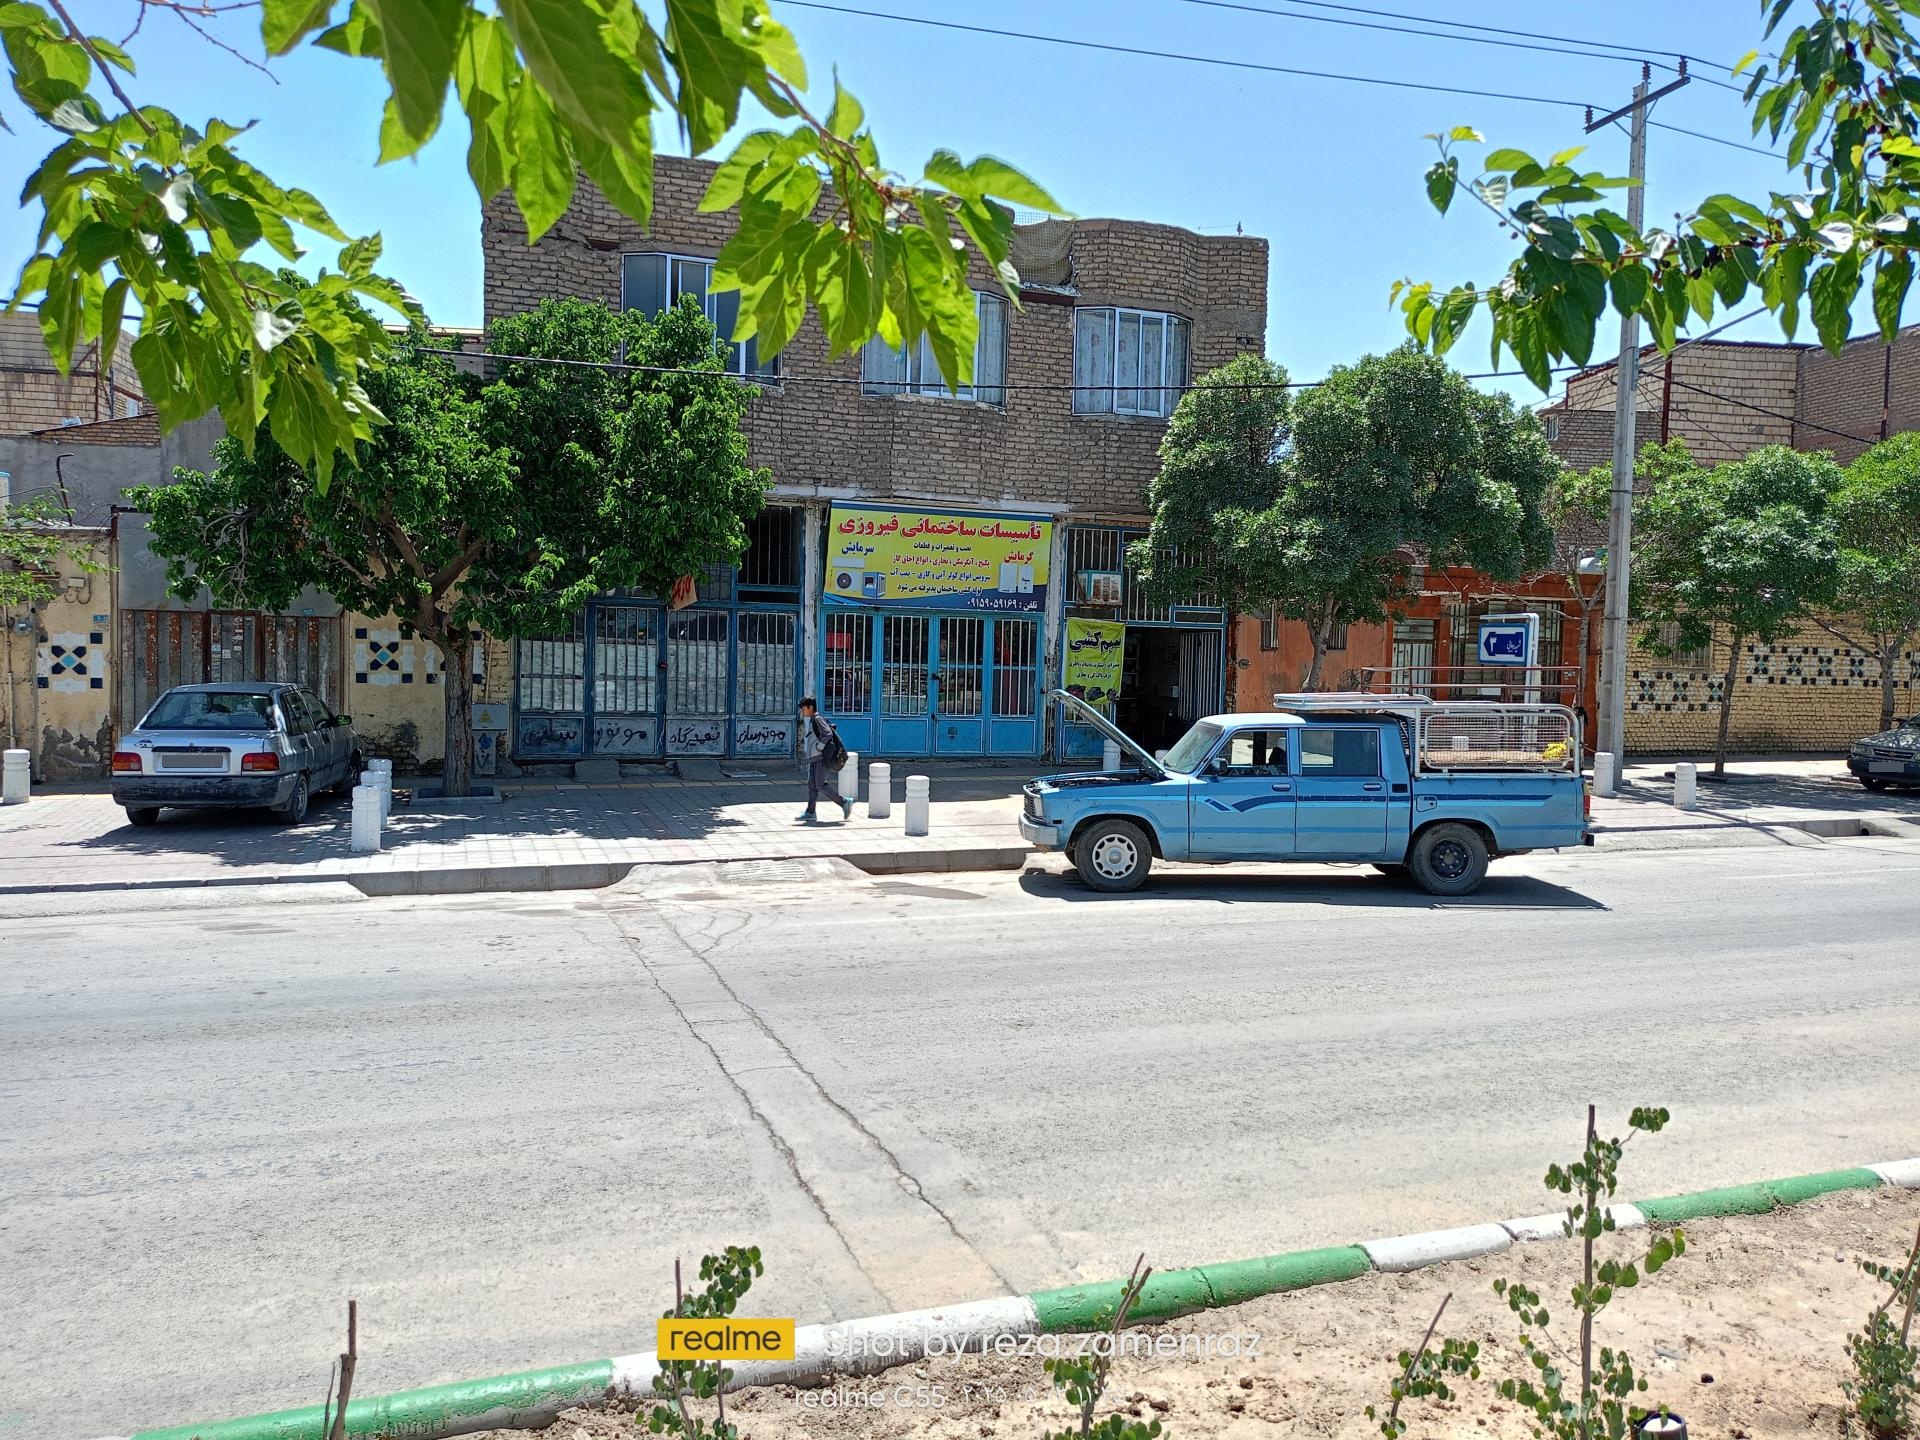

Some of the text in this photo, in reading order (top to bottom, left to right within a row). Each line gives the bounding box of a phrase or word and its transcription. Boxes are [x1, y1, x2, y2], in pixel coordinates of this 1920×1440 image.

[838, 514, 1042, 543] تأسیسات ساختمانی فیروزی
[841, 541, 875, 555] سرمایش
[1003, 550, 1034, 564] گرمایش
[1023, 600, 1038, 611] تلفن
[1069, 631, 1122, 654] سیم کشی
[1489, 636, 1498, 652] ۳
